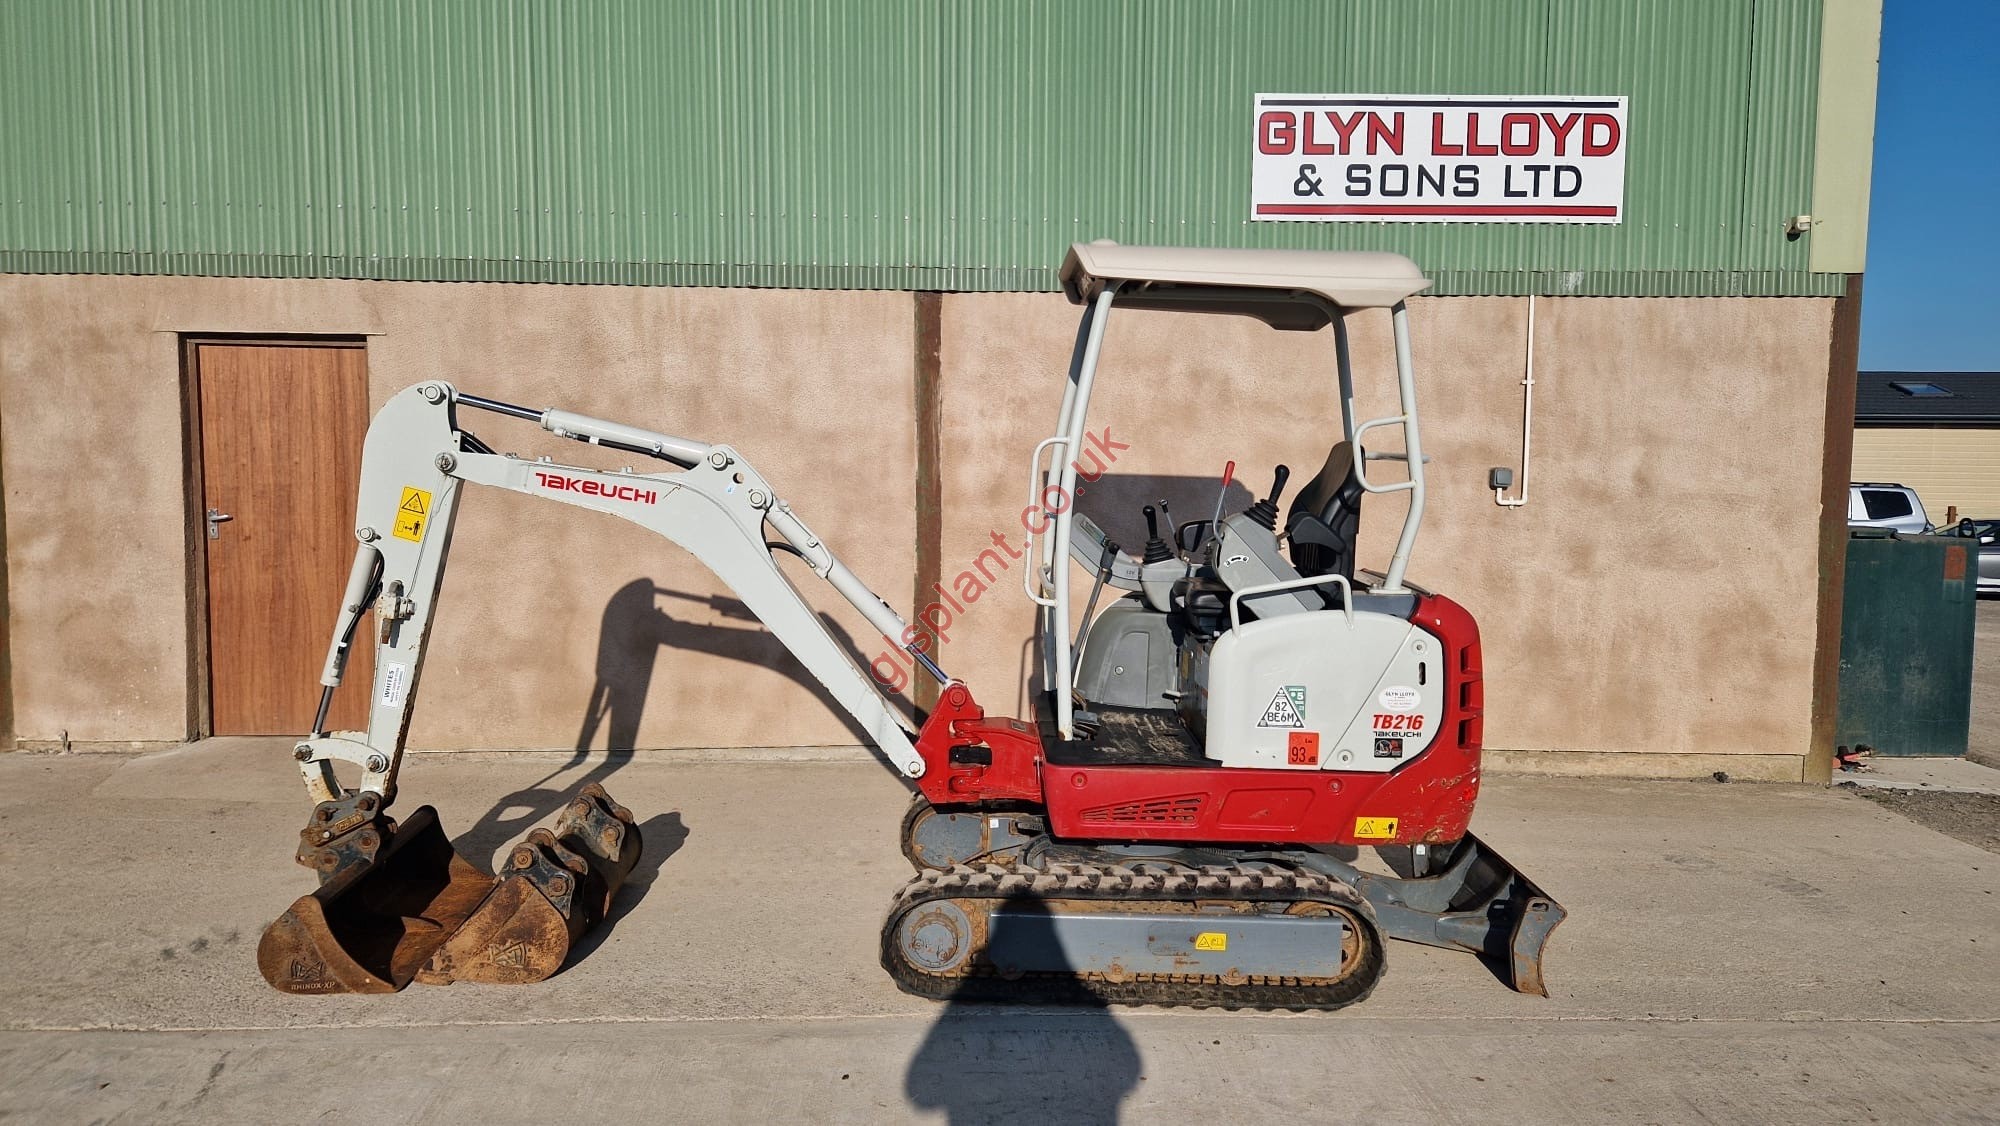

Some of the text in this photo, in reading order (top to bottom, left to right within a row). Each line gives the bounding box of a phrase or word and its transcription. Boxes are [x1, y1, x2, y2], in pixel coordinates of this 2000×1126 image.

[1258, 111, 1621, 157] GLYN LLOYD
[1293, 164, 1582, 198] & SONS LTD
[1274, 701, 1288, 712] 82
[1267, 711, 1295, 722] BE6M
[1373, 714, 1424, 730] TB216
[1291, 746, 1306, 762] 93
